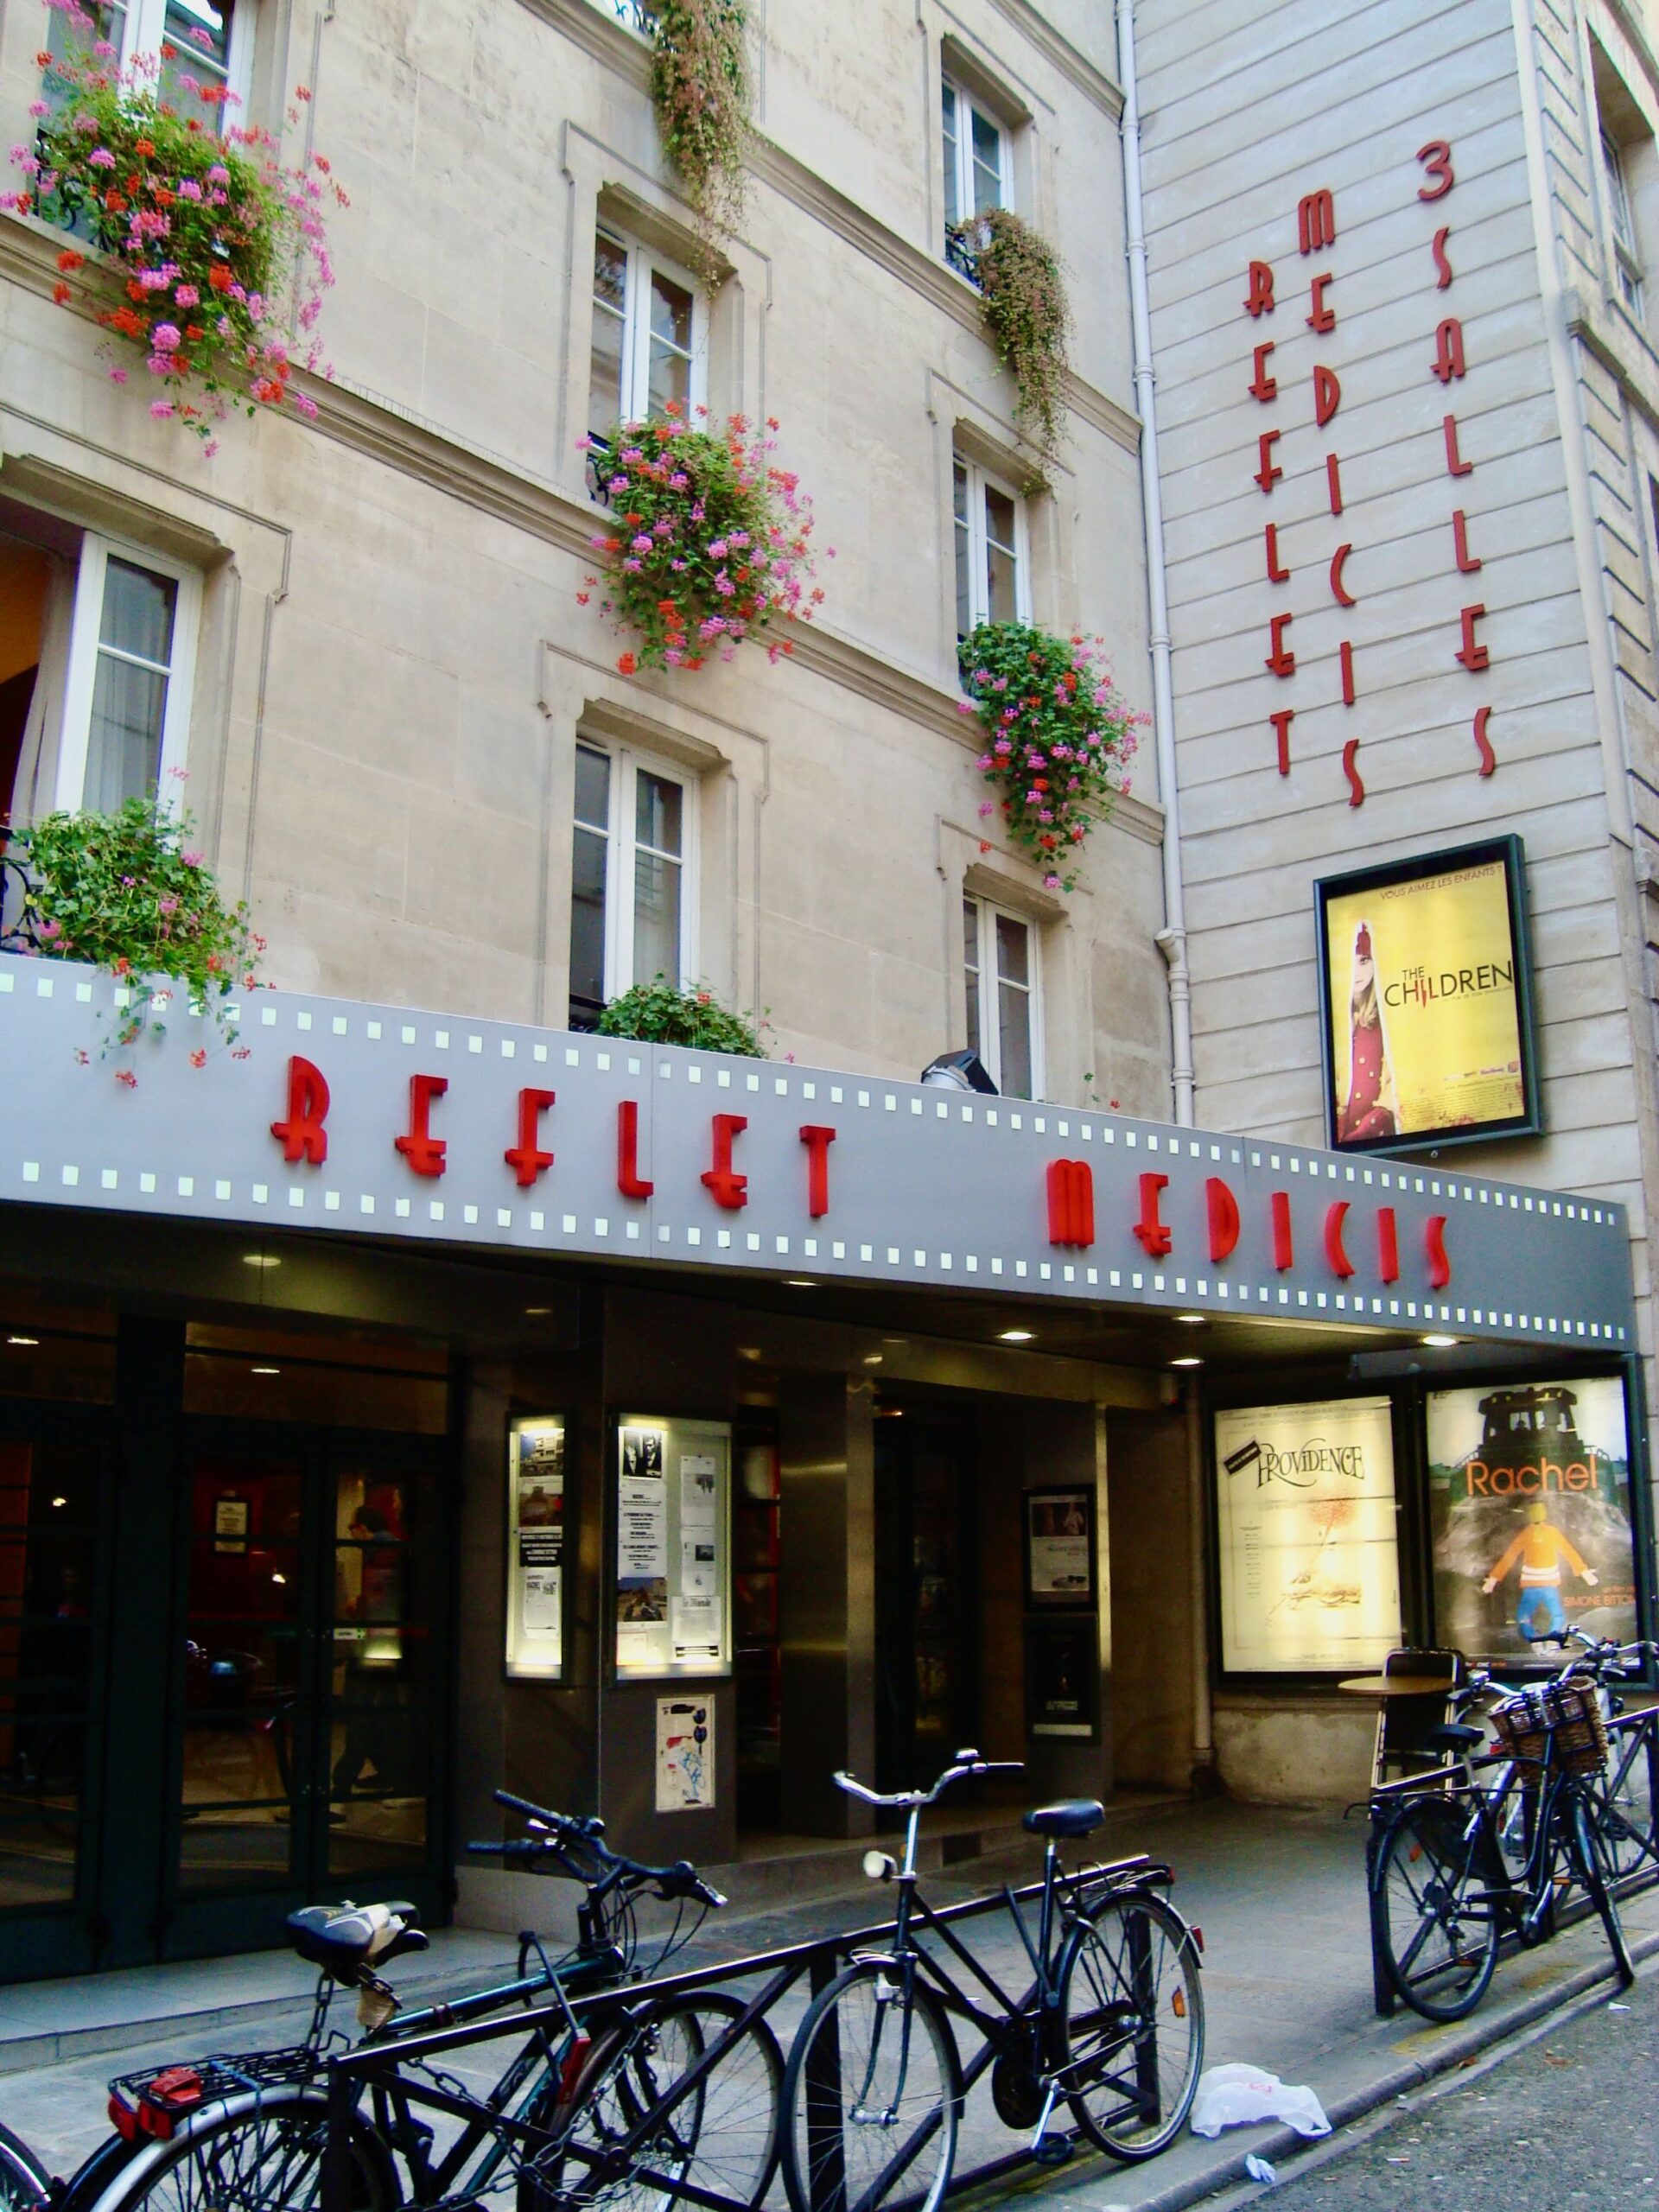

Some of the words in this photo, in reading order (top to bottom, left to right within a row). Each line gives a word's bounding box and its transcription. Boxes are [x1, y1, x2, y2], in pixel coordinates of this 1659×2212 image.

[1415, 140, 1454, 202] 3
[1243, 260, 1294, 776] REFLET
[1298, 188, 1364, 808] MEDICIS
[1429, 226, 1495, 778] SALLES
[1380, 887, 1406, 900] VOUS
[1408, 880, 1436, 895] AIMEZ
[1438, 876, 1452, 888] LES
[1454, 866, 1496, 885] ENFANTS
[1384, 960, 1513, 1008] CHILDREN
[1402, 966, 1425, 981] THE
[270, 1055, 836, 1217] REFLET
[1046, 1158, 1451, 1290] MEDICIS
[1257, 1438, 1365, 1490] PROVIDENCE
[1465, 1452, 1599, 1497] Rachel
